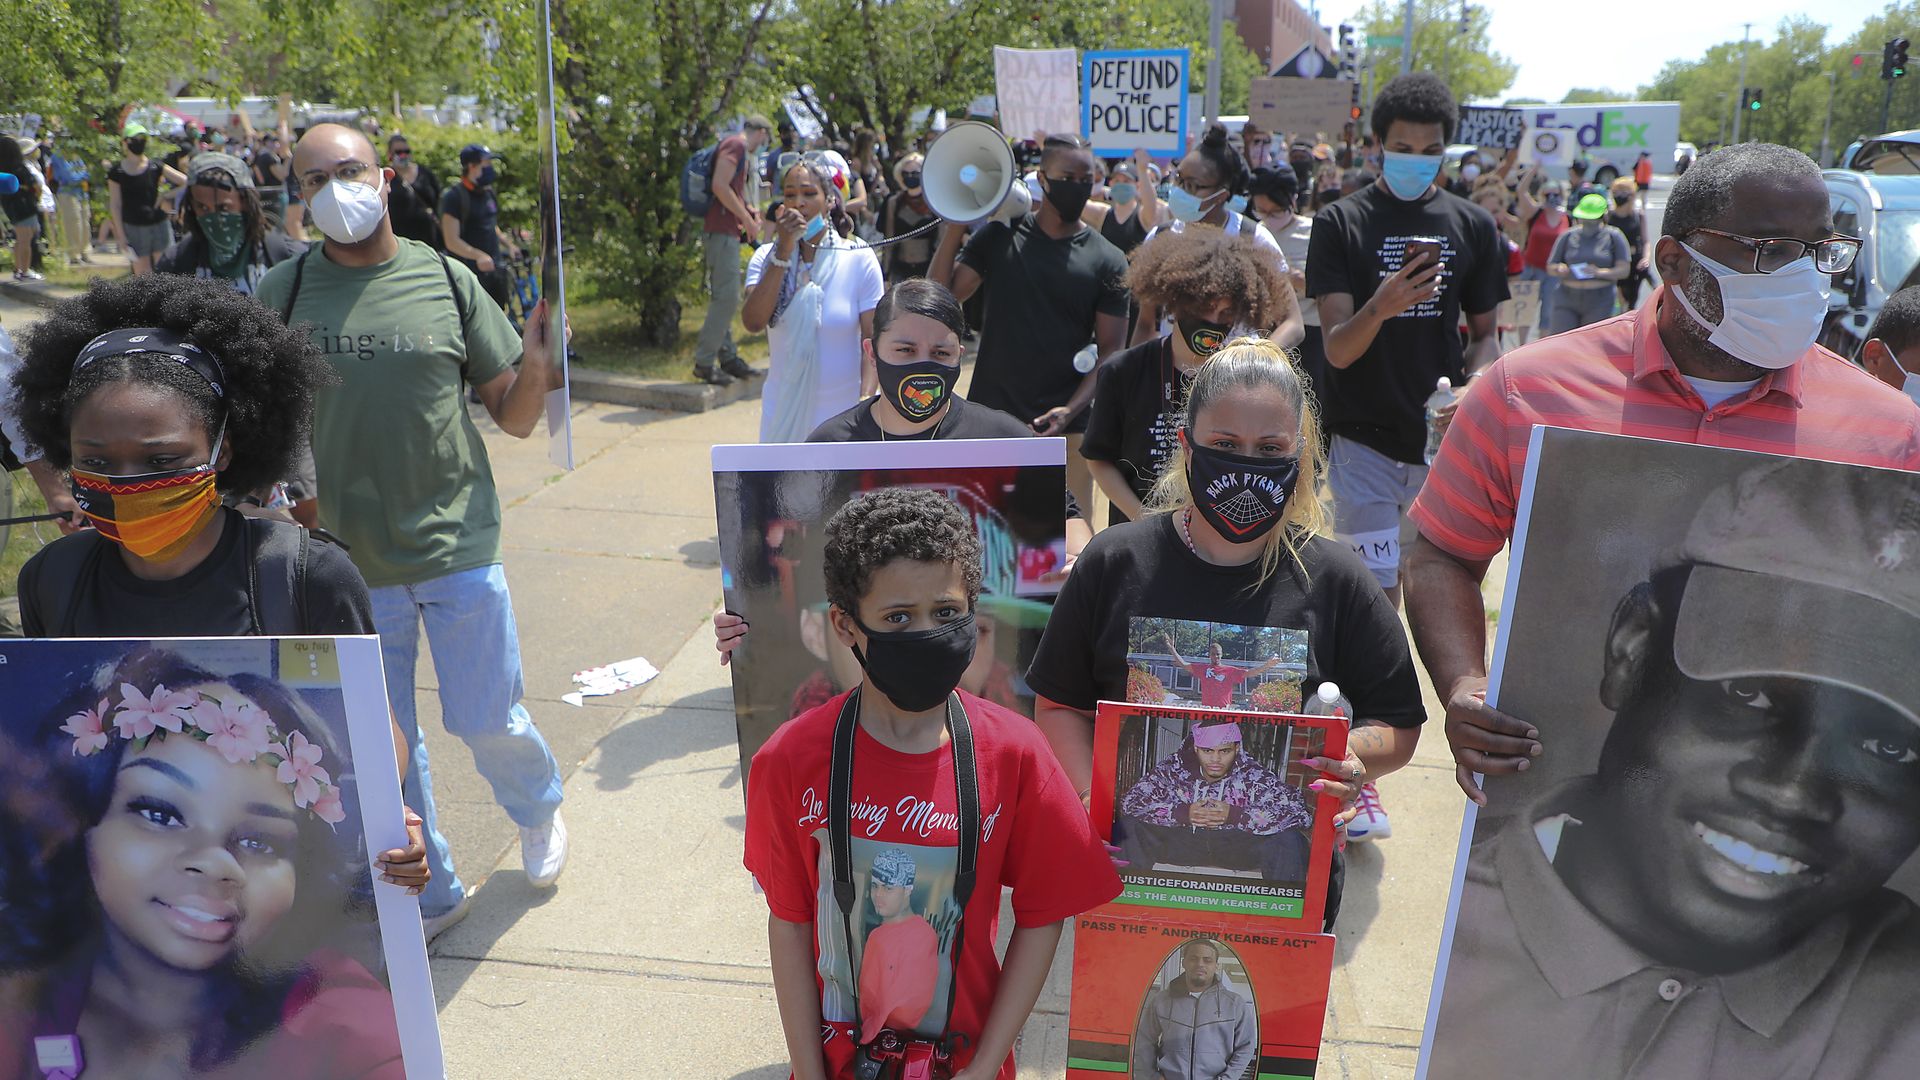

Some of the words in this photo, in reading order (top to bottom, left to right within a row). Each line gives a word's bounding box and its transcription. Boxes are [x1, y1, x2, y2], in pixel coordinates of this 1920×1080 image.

[1091, 59, 1179, 91] DEFUND
[1116, 92, 1152, 105] THE
[1091, 104, 1179, 134] POLICE
[1462, 110, 1522, 130] JUSTICE
[1460, 127, 1518, 149] PEACE
[1206, 473, 1239, 499] BLACK
[1243, 473, 1285, 505] PYRAMID
[1201, 712, 1237, 723] CAN'T
[1241, 716, 1297, 727] BREATHE
[799, 787, 824, 827] In
[983, 803, 1002, 842] of
[1119, 874, 1303, 898] JUSTICEFORANDREWKEARSE
[1117, 890, 1141, 899] ASS
[1143, 892, 1167, 902] THE
[1169, 894, 1220, 906] ANDREW
[1222, 898, 1268, 911] KEARSE
[1270, 902, 1294, 912] ACT
[1081, 920, 1116, 931] PASS
[1120, 924, 1148, 934] THE
[1161, 927, 1221, 940] ANDREW
[1223, 932, 1279, 946] KEARSE
